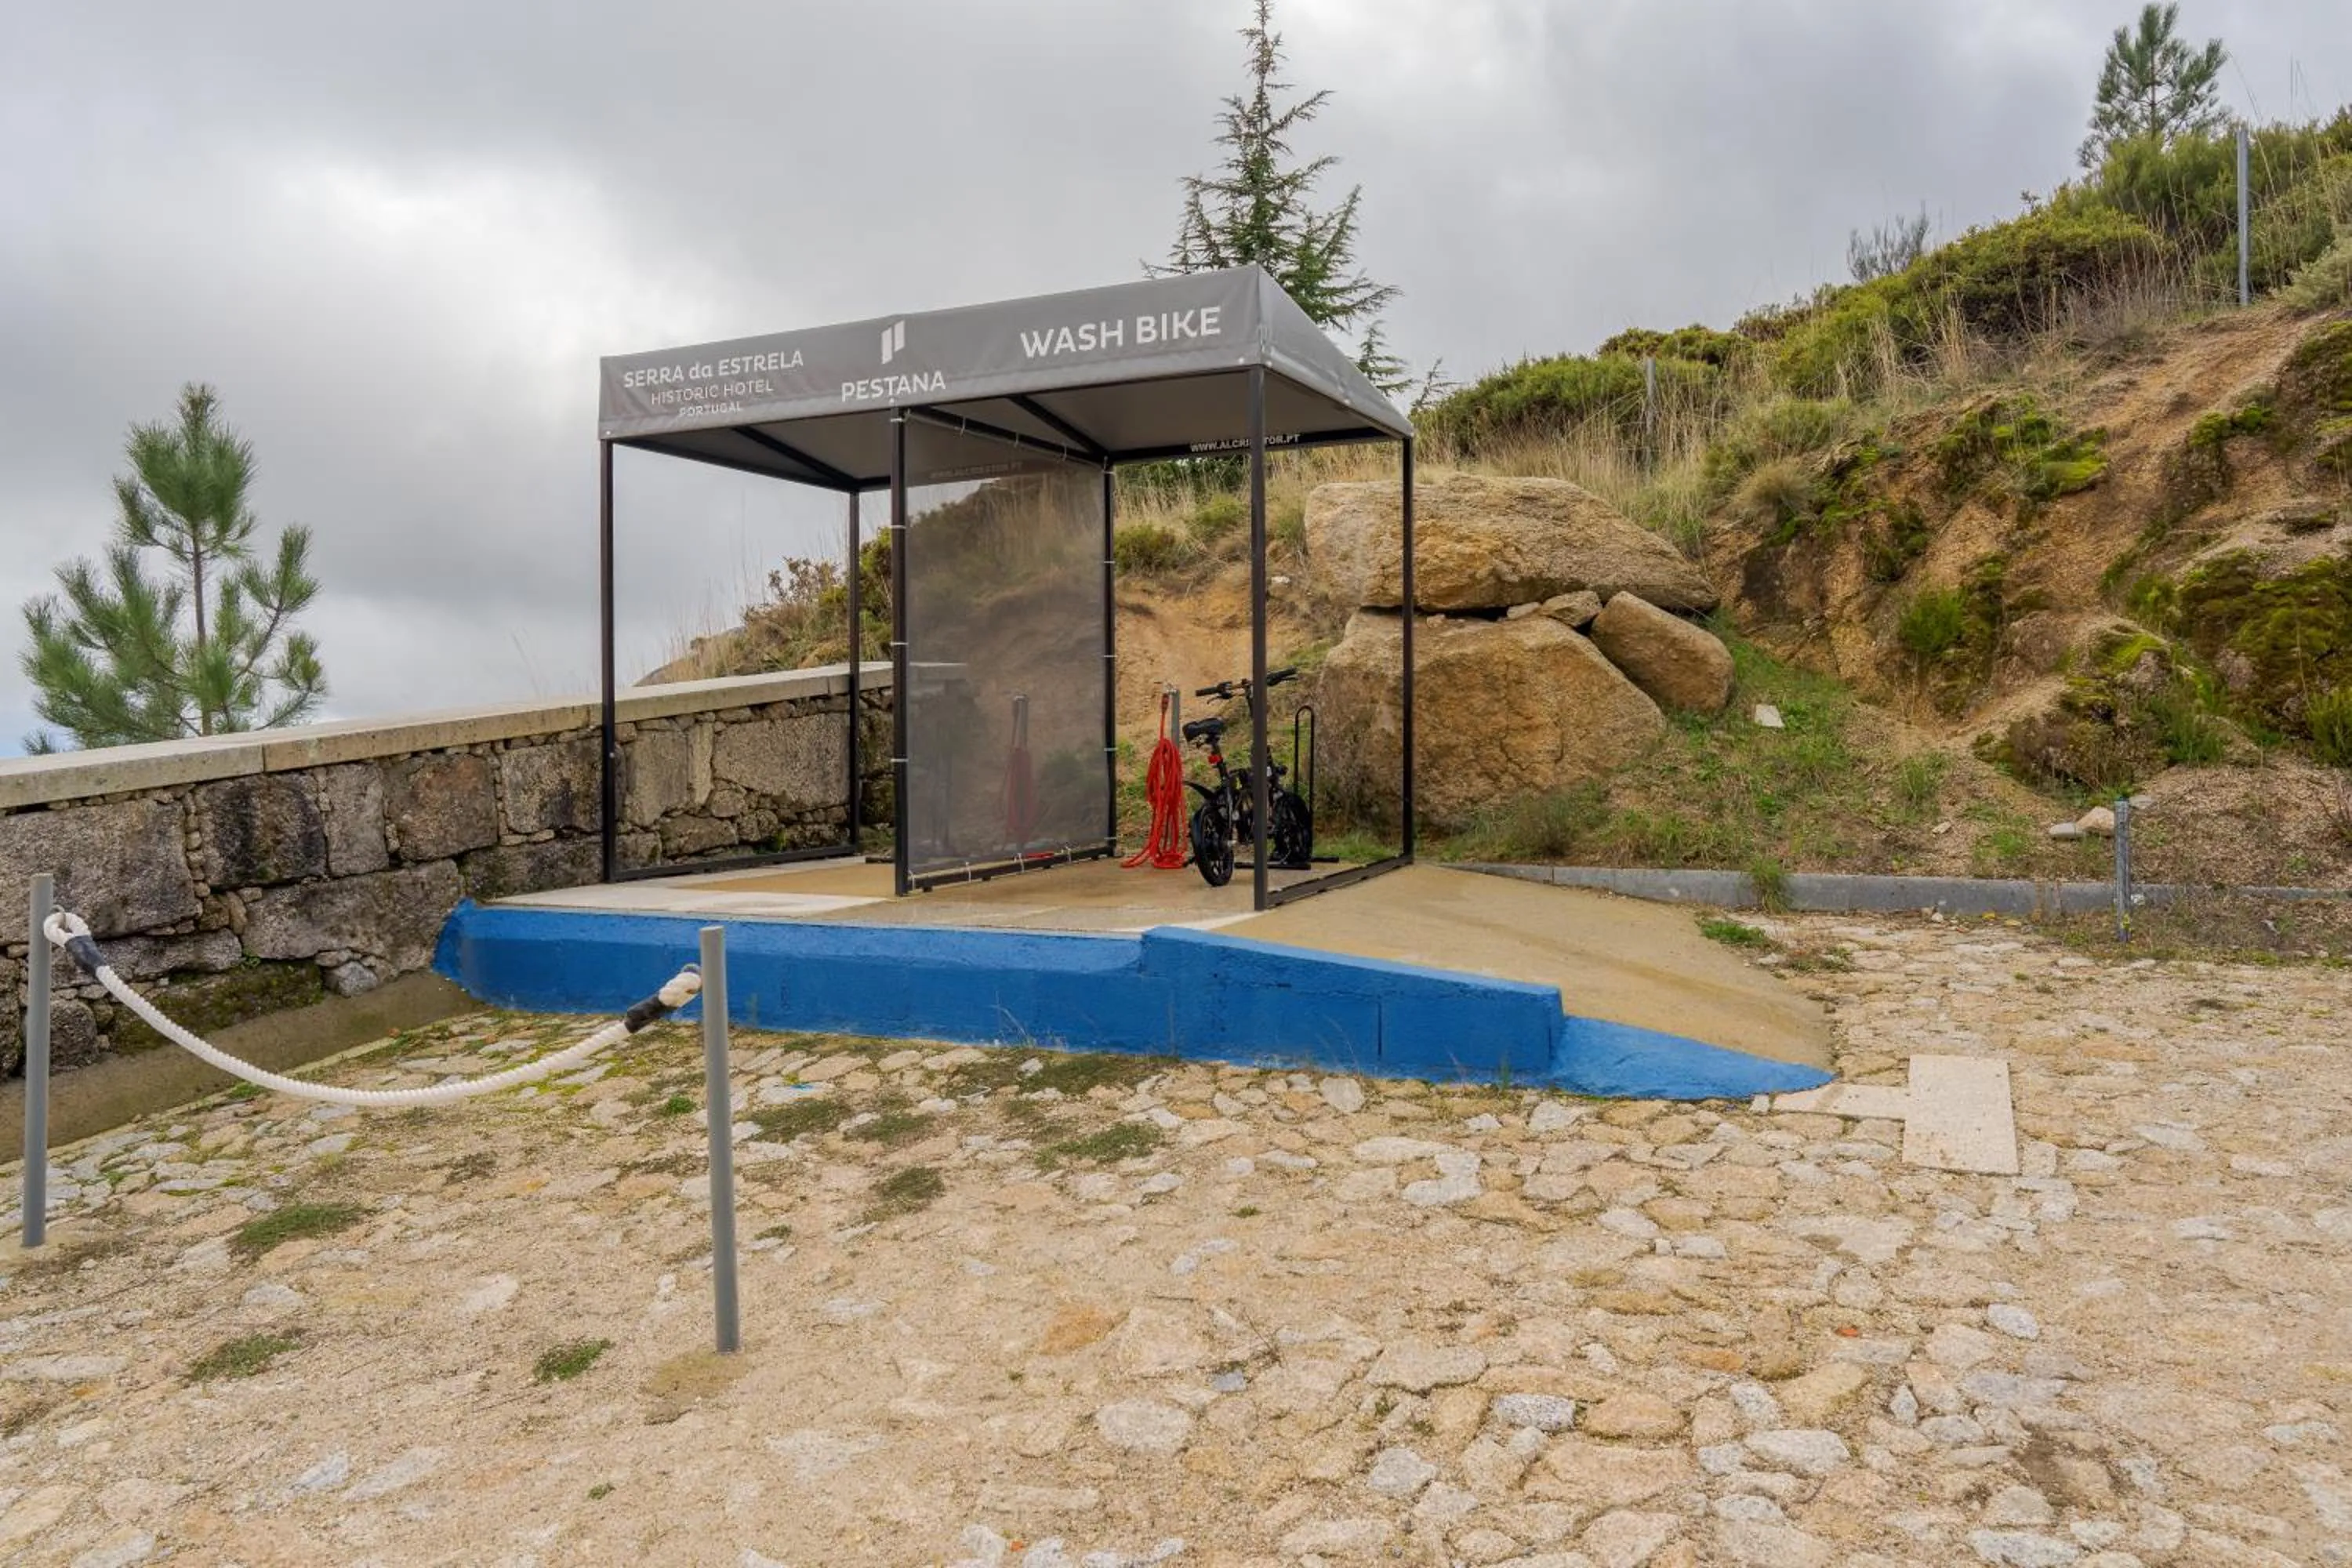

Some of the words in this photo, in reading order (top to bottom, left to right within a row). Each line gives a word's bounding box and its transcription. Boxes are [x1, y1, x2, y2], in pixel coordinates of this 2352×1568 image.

[1020, 319, 1123, 358] WASH
[1136, 306, 1221, 344] BIKE
[623, 365, 684, 388] SERRA
[688, 361, 713, 380] da
[718, 350, 804, 376] ESTRELA
[652, 383, 719, 405] HISTORIC
[724, 379, 774, 396] HOTEL
[841, 370, 946, 402] PESTANA
[678, 401, 743, 418] PORTUGAL
